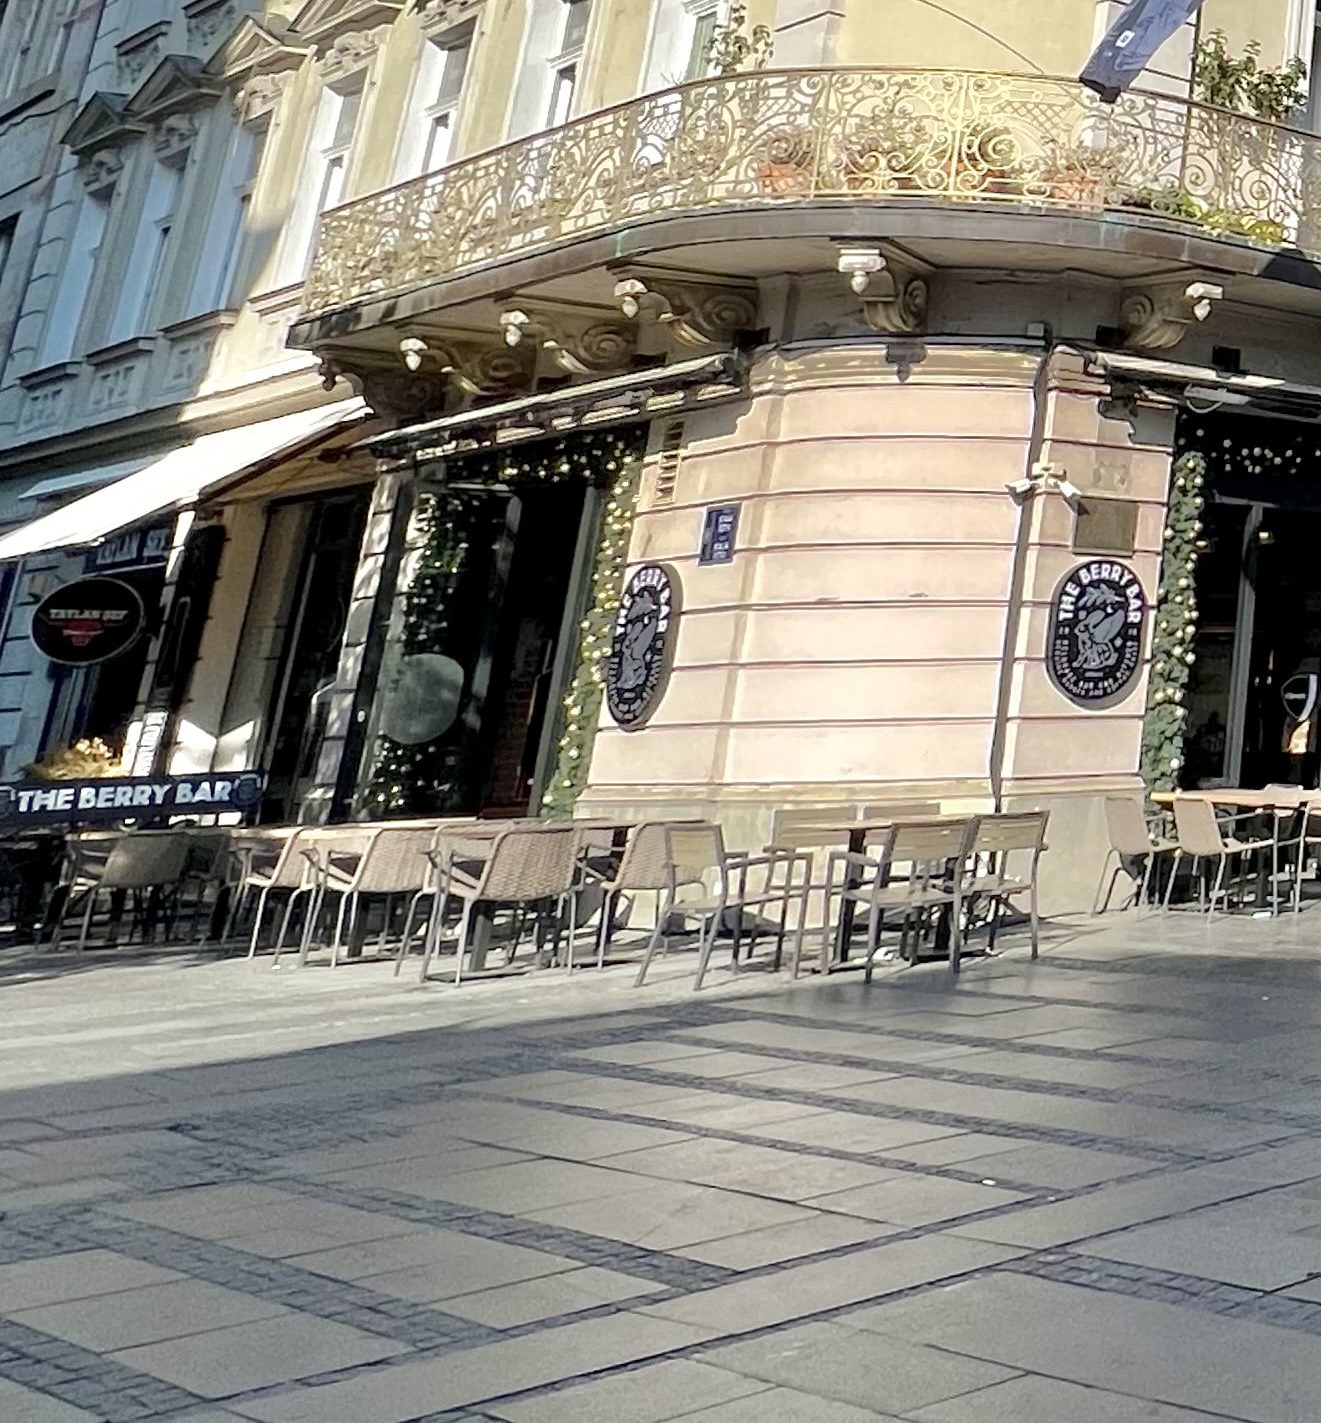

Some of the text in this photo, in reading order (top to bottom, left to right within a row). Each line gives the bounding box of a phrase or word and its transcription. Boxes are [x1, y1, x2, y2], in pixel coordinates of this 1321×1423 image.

[1058, 563, 1143, 623] THE BERRY BAR
[17, 780, 233, 813] THE BERRY BAR
